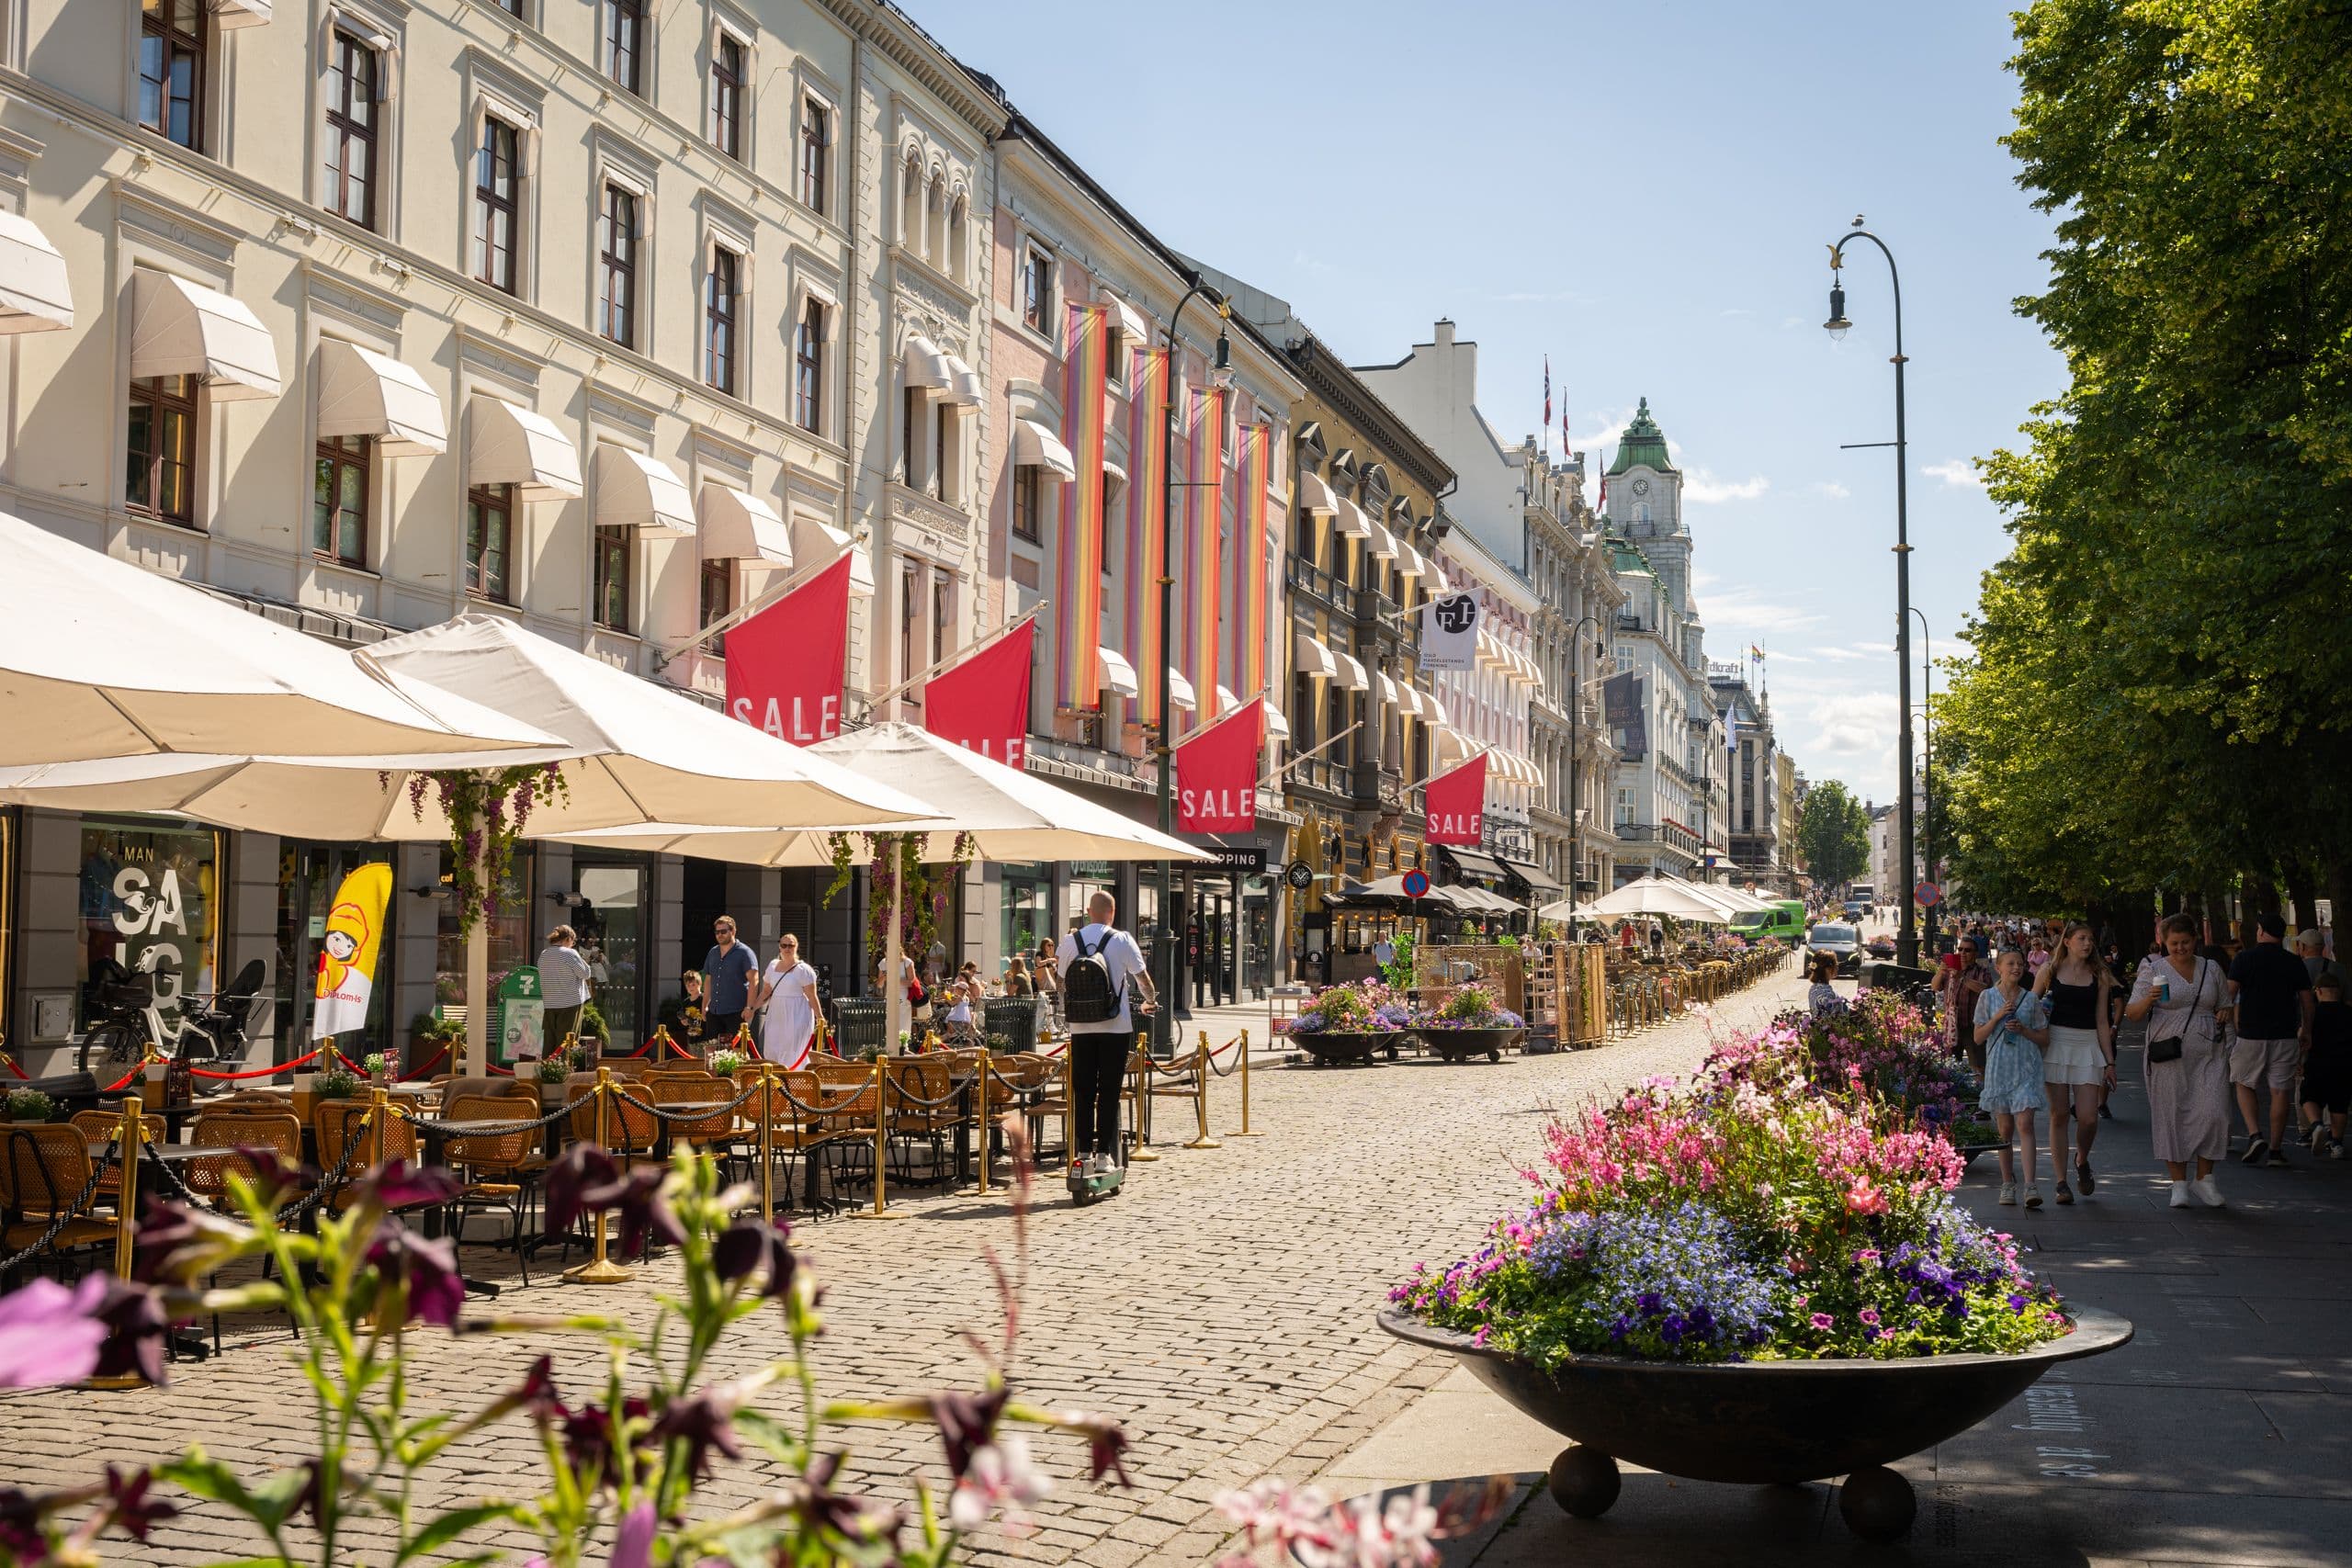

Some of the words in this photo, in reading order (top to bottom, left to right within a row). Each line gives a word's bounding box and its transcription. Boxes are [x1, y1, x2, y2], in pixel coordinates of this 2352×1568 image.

[1708, 661, 1738, 673] dkraft
[733, 695, 837, 740] SALE
[1182, 789, 1252, 818] SALE
[1429, 814, 1480, 834] SALE
[124, 847, 154, 862] MAN
[1613, 856, 1631, 864] AND
[112, 867, 187, 935] SA
[2035, 1446, 2111, 1458] at
[2038, 1462, 2100, 1477] se
